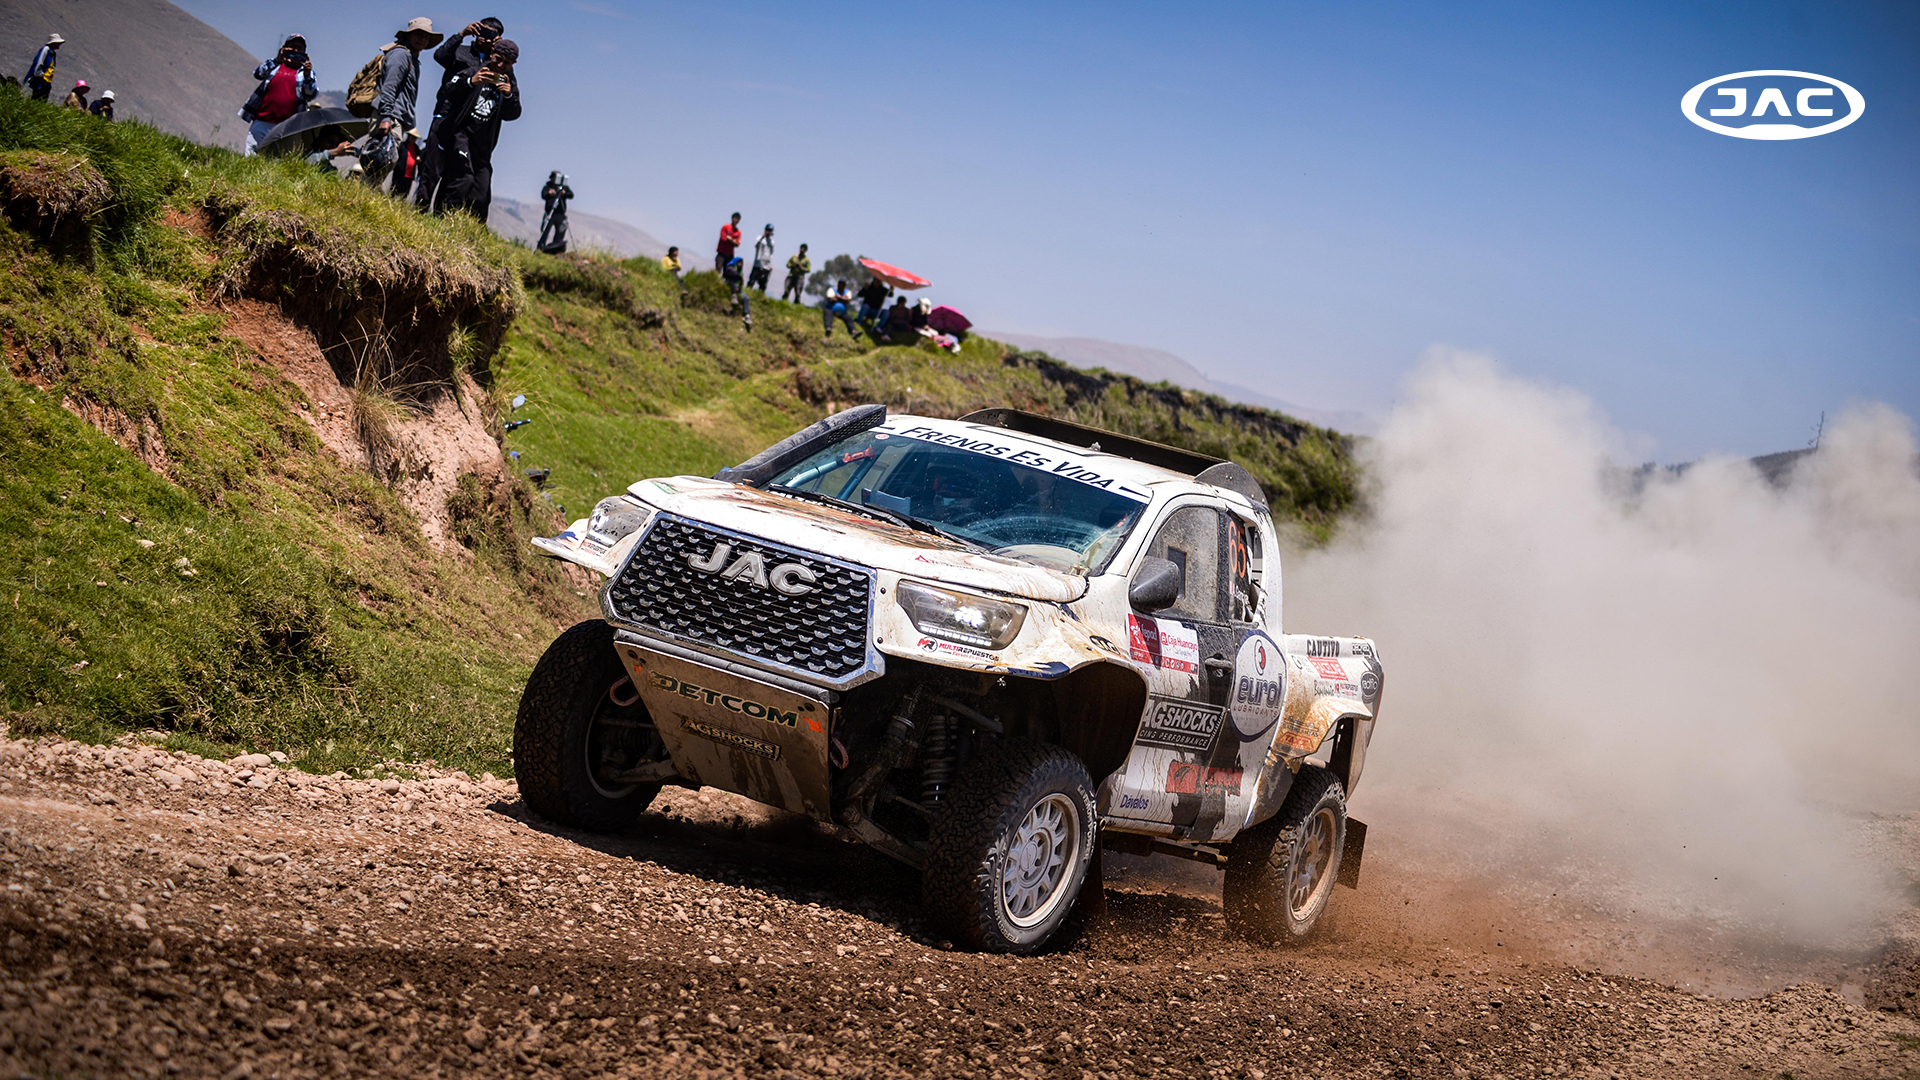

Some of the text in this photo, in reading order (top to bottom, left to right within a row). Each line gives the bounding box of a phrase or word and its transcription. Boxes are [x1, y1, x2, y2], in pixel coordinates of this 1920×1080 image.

[899, 426, 1011, 456] FRENOS
[1051, 461, 1115, 489] VIDA
[687, 542, 817, 597] JAC
[938, 642, 1000, 662] MULTIREPUESTOS
[1306, 639, 1340, 657] CAUTIVO
[1237, 673, 1283, 709] eurol
[1233, 704, 1280, 719] LUBRICANTS
[1139, 729, 1209, 747] CING PERFORMANCE
[1120, 794, 1149, 810] Dávalos
